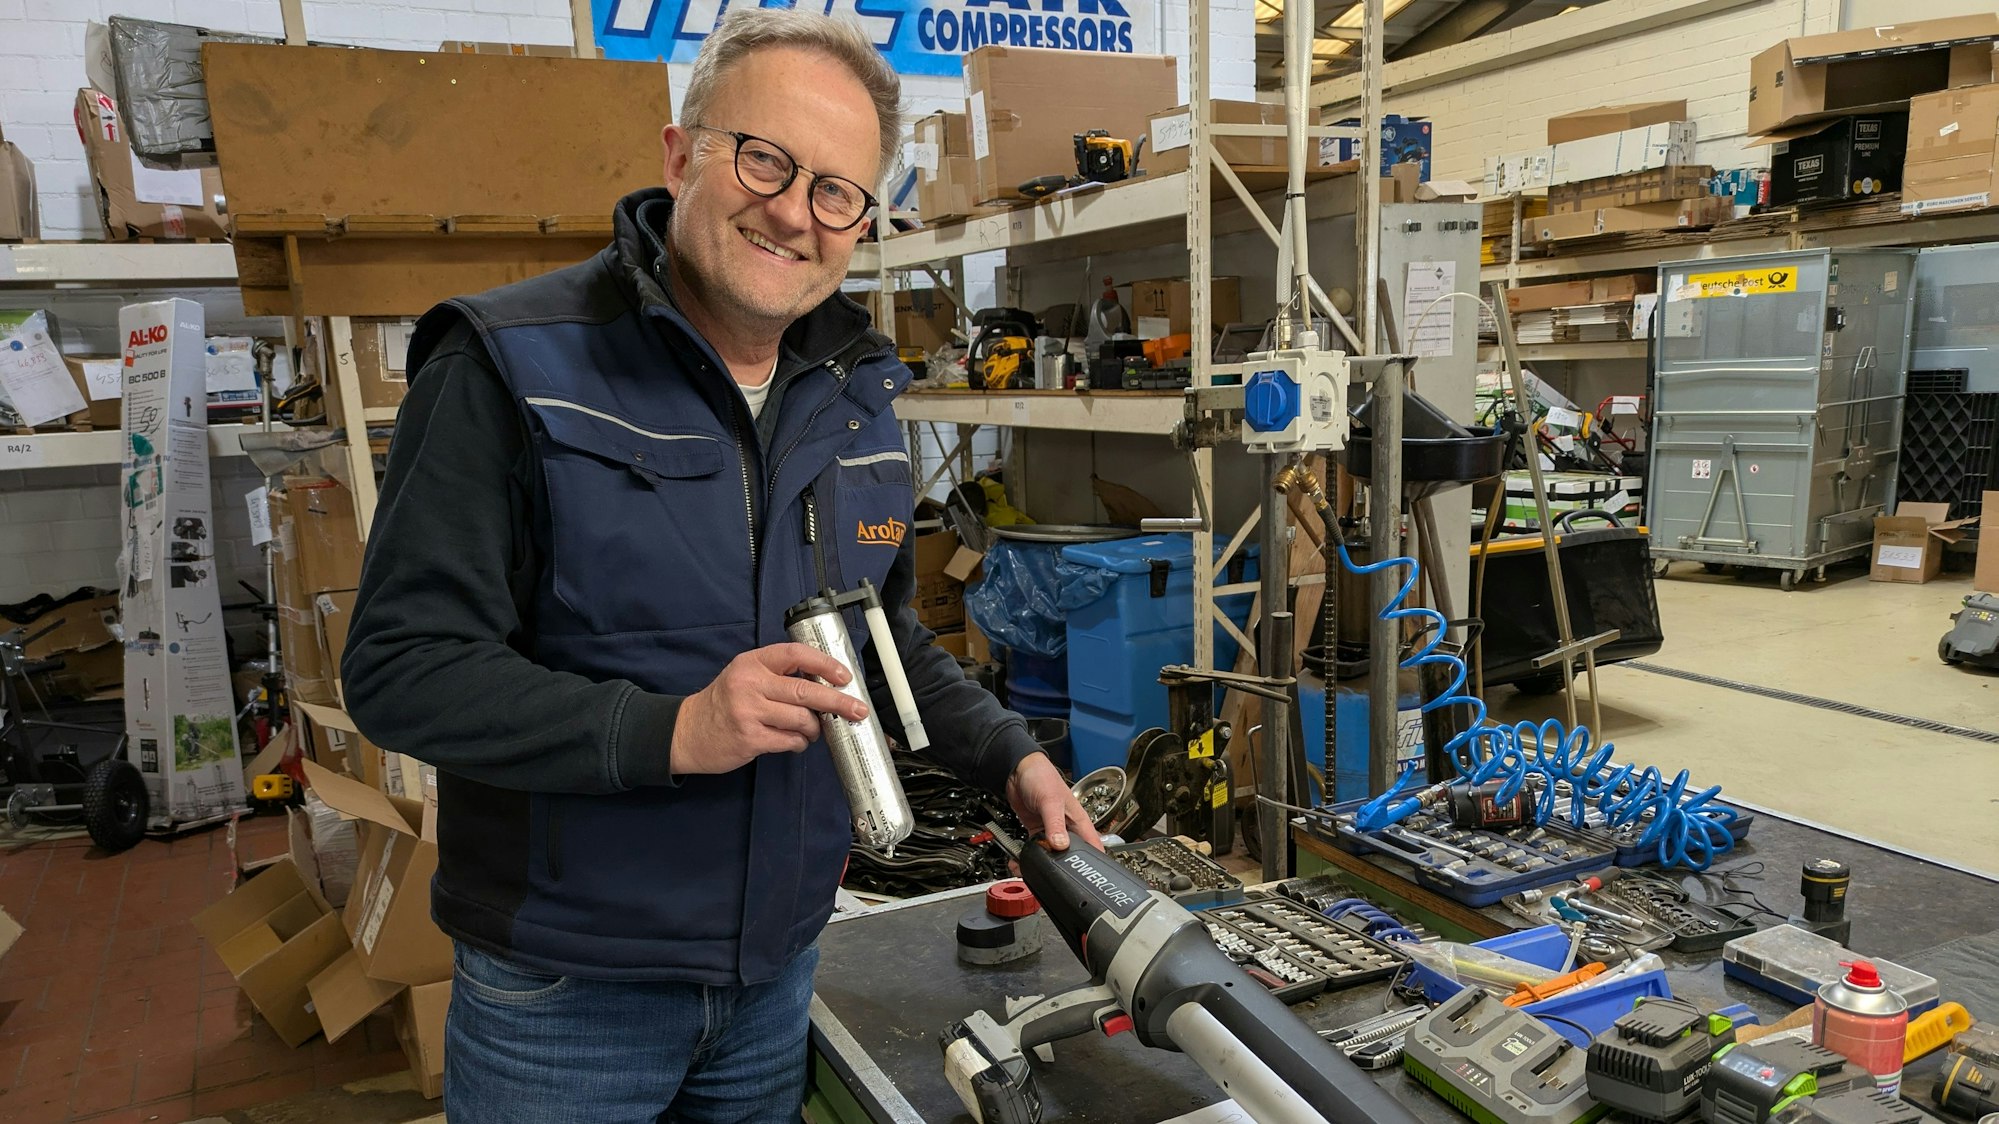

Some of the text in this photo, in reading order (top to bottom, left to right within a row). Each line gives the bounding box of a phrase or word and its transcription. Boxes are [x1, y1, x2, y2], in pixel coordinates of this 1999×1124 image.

[917, 8, 1133, 53] COMPRESSORS
[1858, 123, 1878, 133] TEXAS
[1854, 142, 1880, 151] PREMIUM
[1797, 159, 1820, 171] TEXAS
[1700, 277, 1764, 291] eutsche Post
[180, 322, 201, 331] AL-KO
[128, 325, 168, 348] AL-KO
[128, 374, 141, 385] BC
[142, 371, 159, 382] 500
[7, 444, 32, 454] R4/2
[879, 808, 892, 838] VOLVO
[1064, 854, 1135, 908] POWERCURE
[1683, 1061, 1712, 1086] LUX-TOOLS
